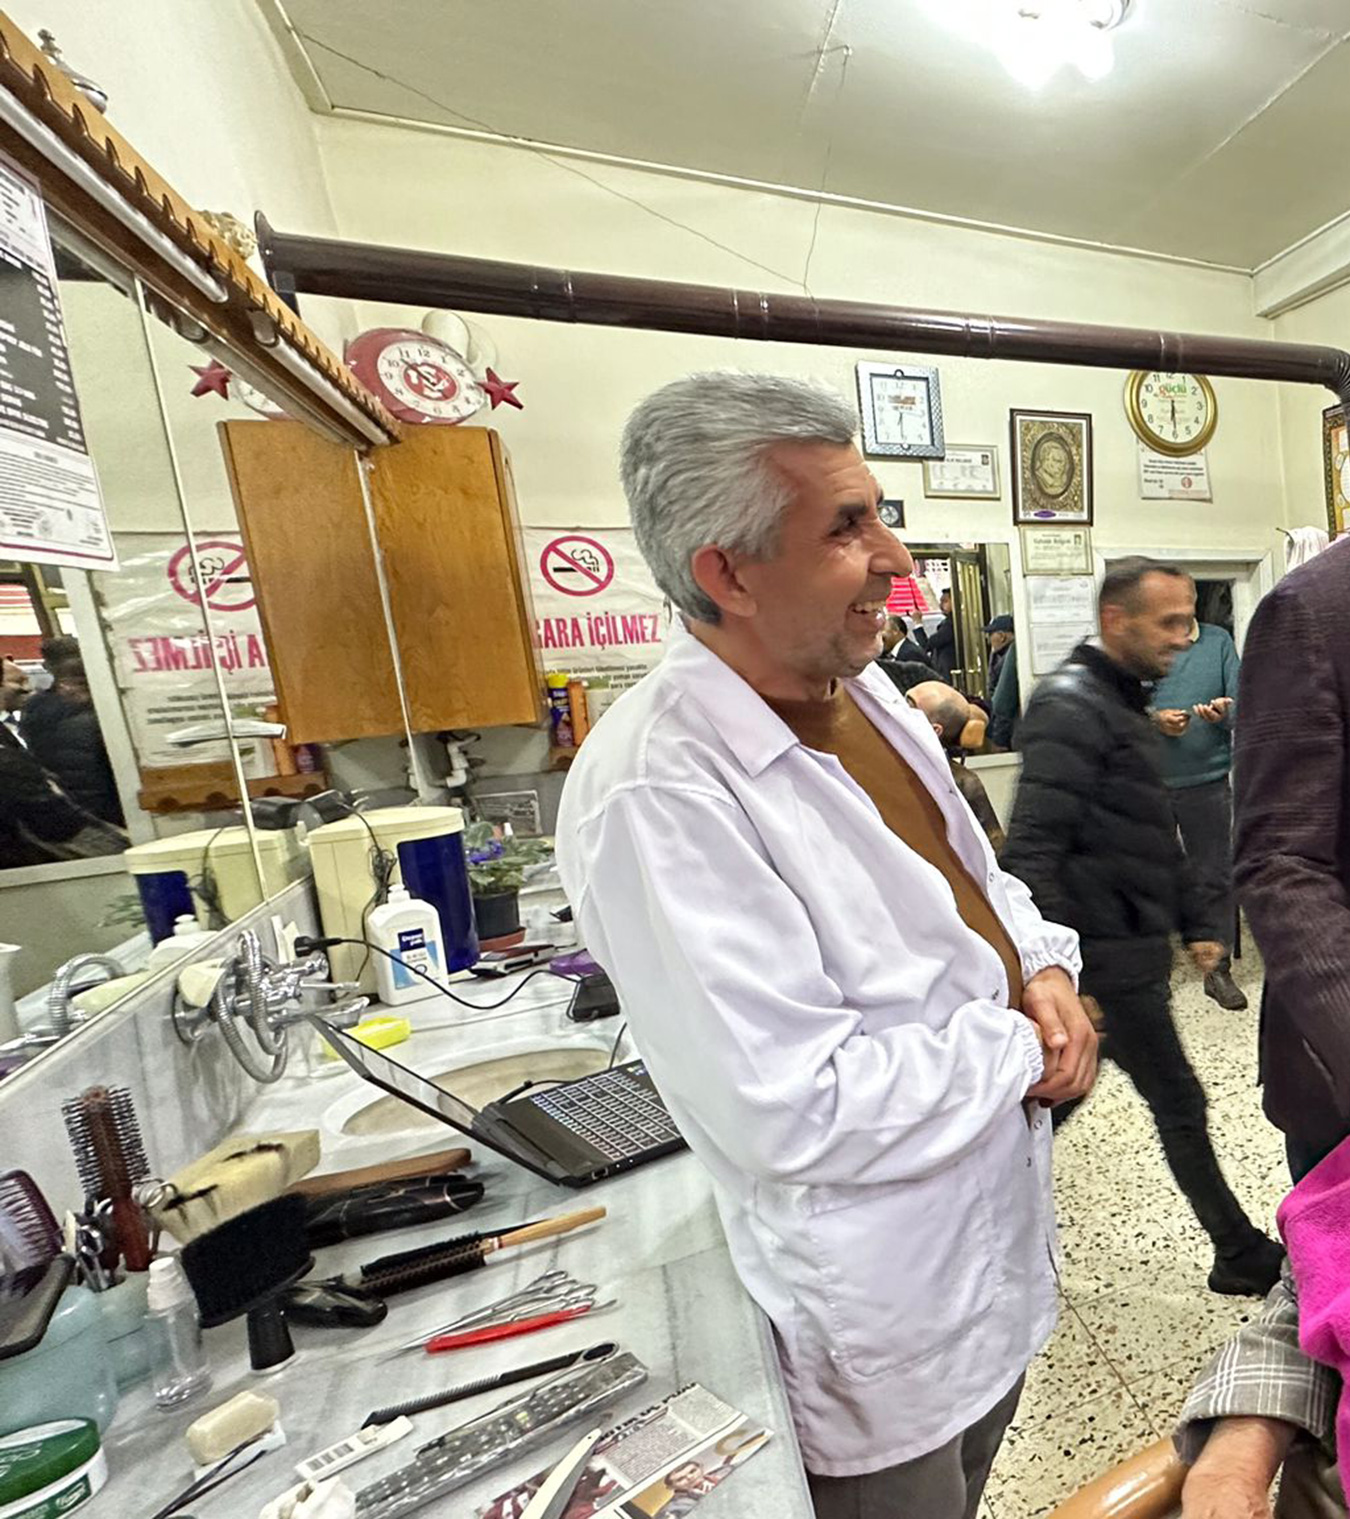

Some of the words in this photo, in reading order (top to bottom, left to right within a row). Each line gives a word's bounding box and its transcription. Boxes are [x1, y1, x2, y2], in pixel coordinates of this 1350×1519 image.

[417, 348, 431, 358] 12
[386, 358, 400, 368] 10
[1153, 374, 1161, 383] 11
[1144, 383, 1154, 393] 10
[1191, 386, 1198, 396] 2
[1141, 398, 1148, 408] 9
[1196, 401, 1204, 411] 3
[1147, 413, 1155, 424] 8
[1194, 416, 1200, 425] 4
[1158, 425, 1164, 435] 7
[1171, 429, 1179, 440] 6
[1184, 425, 1192, 435] 5
[586, 611, 662, 651] İÇİLMEZ
